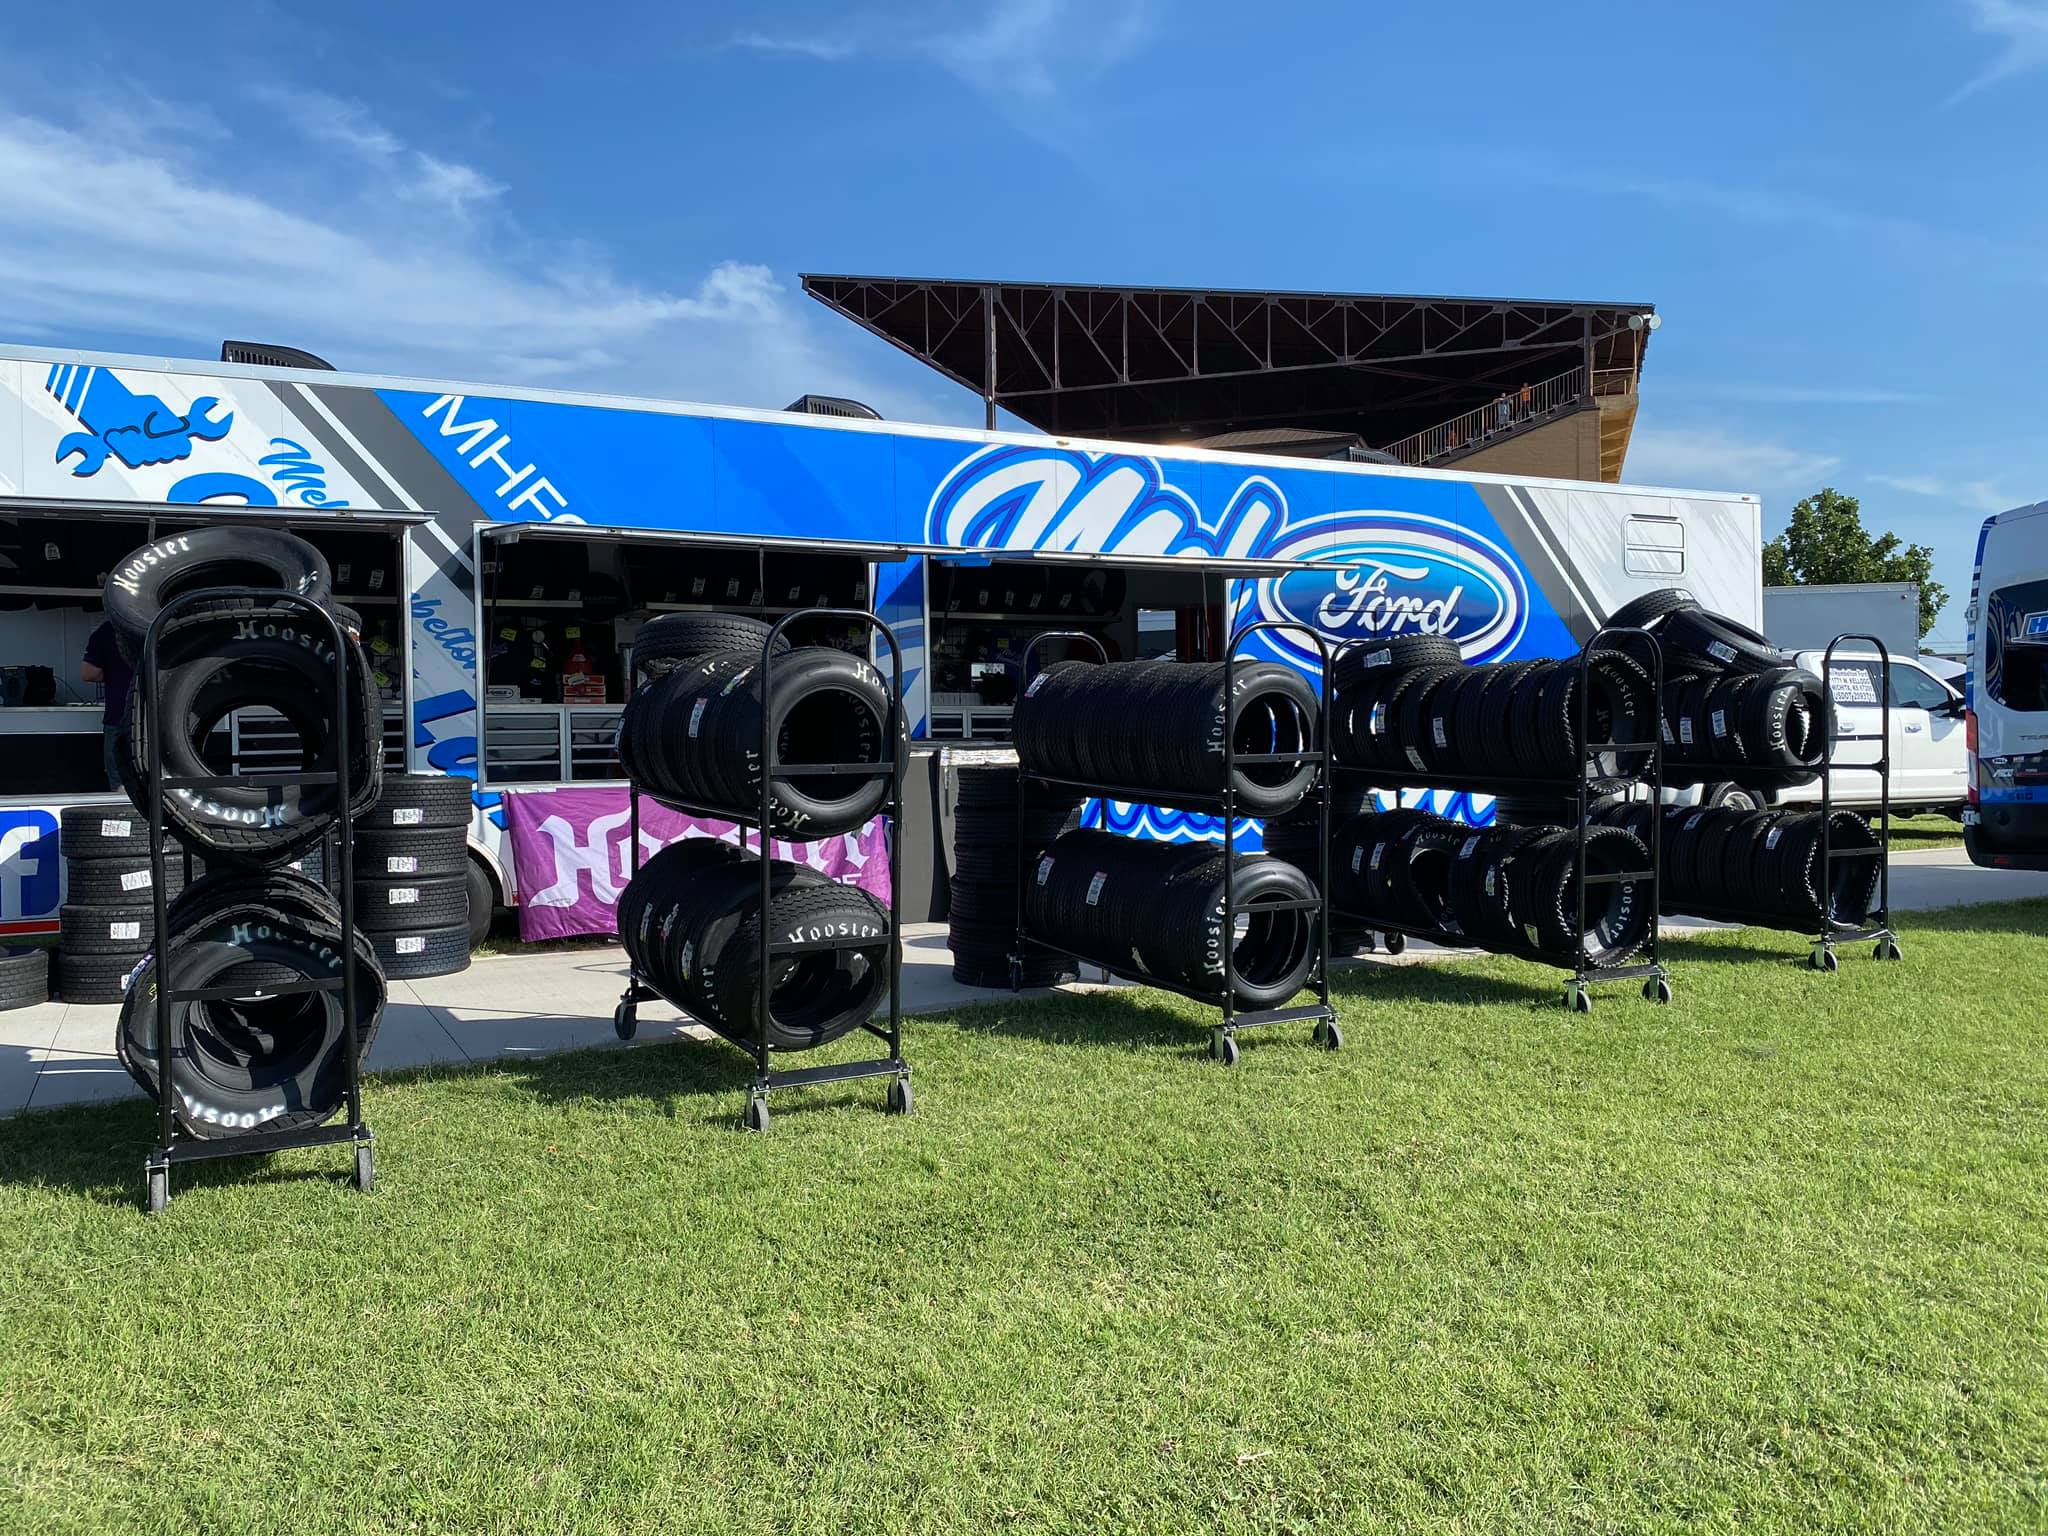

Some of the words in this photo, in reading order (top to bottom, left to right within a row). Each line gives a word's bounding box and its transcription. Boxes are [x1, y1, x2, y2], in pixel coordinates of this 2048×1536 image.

[422, 394, 588, 523] MHF
[112, 536, 190, 596] Hoosier
[1315, 565, 1460, 638] Ford
[231, 619, 336, 664] Hoosie
[1206, 679, 1248, 761] Hooser
[1769, 690, 1788, 752] Hoosier
[177, 787, 287, 829] Hoosi
[746, 749, 812, 830] Hooier
[788, 922, 879, 943] Hoosier
